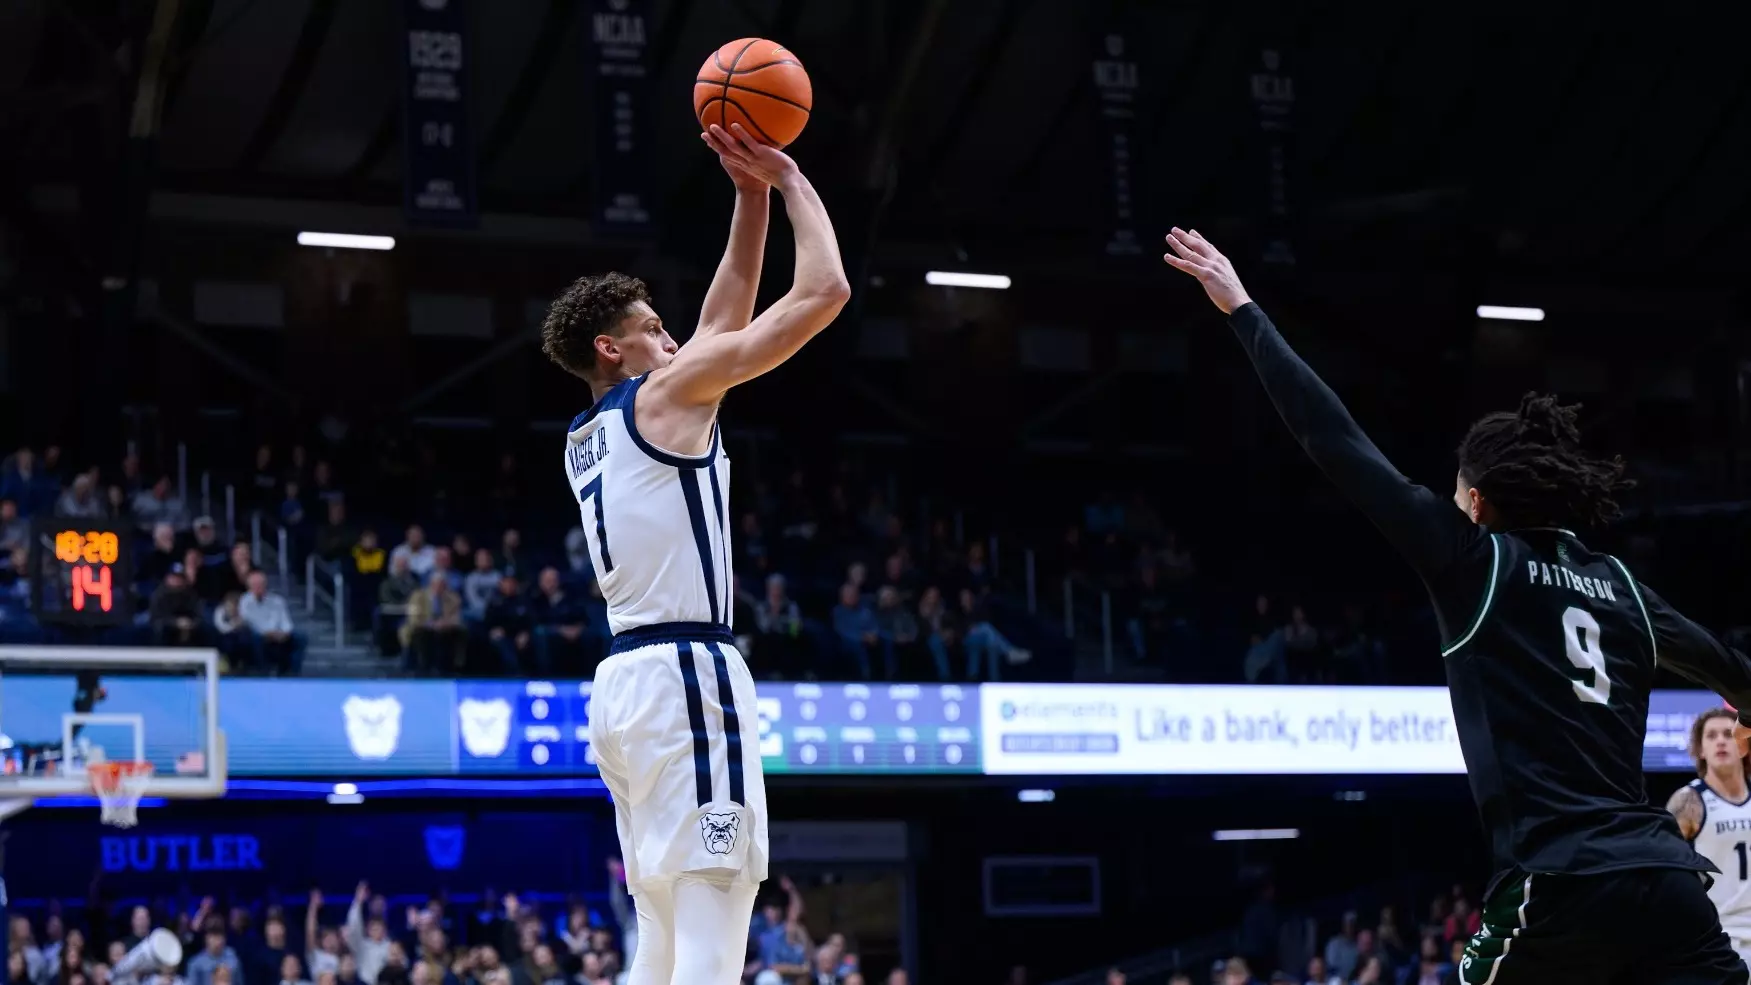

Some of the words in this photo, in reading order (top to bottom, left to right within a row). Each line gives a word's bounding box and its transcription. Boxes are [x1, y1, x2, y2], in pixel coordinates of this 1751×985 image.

[596, 426, 610, 462] JR.
[580, 472, 613, 574] 7
[72, 565, 112, 612] 14
[1528, 560, 1616, 602] PATTERSON
[1562, 606, 1611, 705] 9
[1135, 708, 1191, 743] Like
[1201, 716, 1216, 743] a
[1224, 708, 1299, 749] bank,
[1306, 708, 1361, 751] only
[1369, 708, 1455, 743] better.
[1716, 818, 1751, 835] BUT
[100, 833, 263, 873] BUTLER
